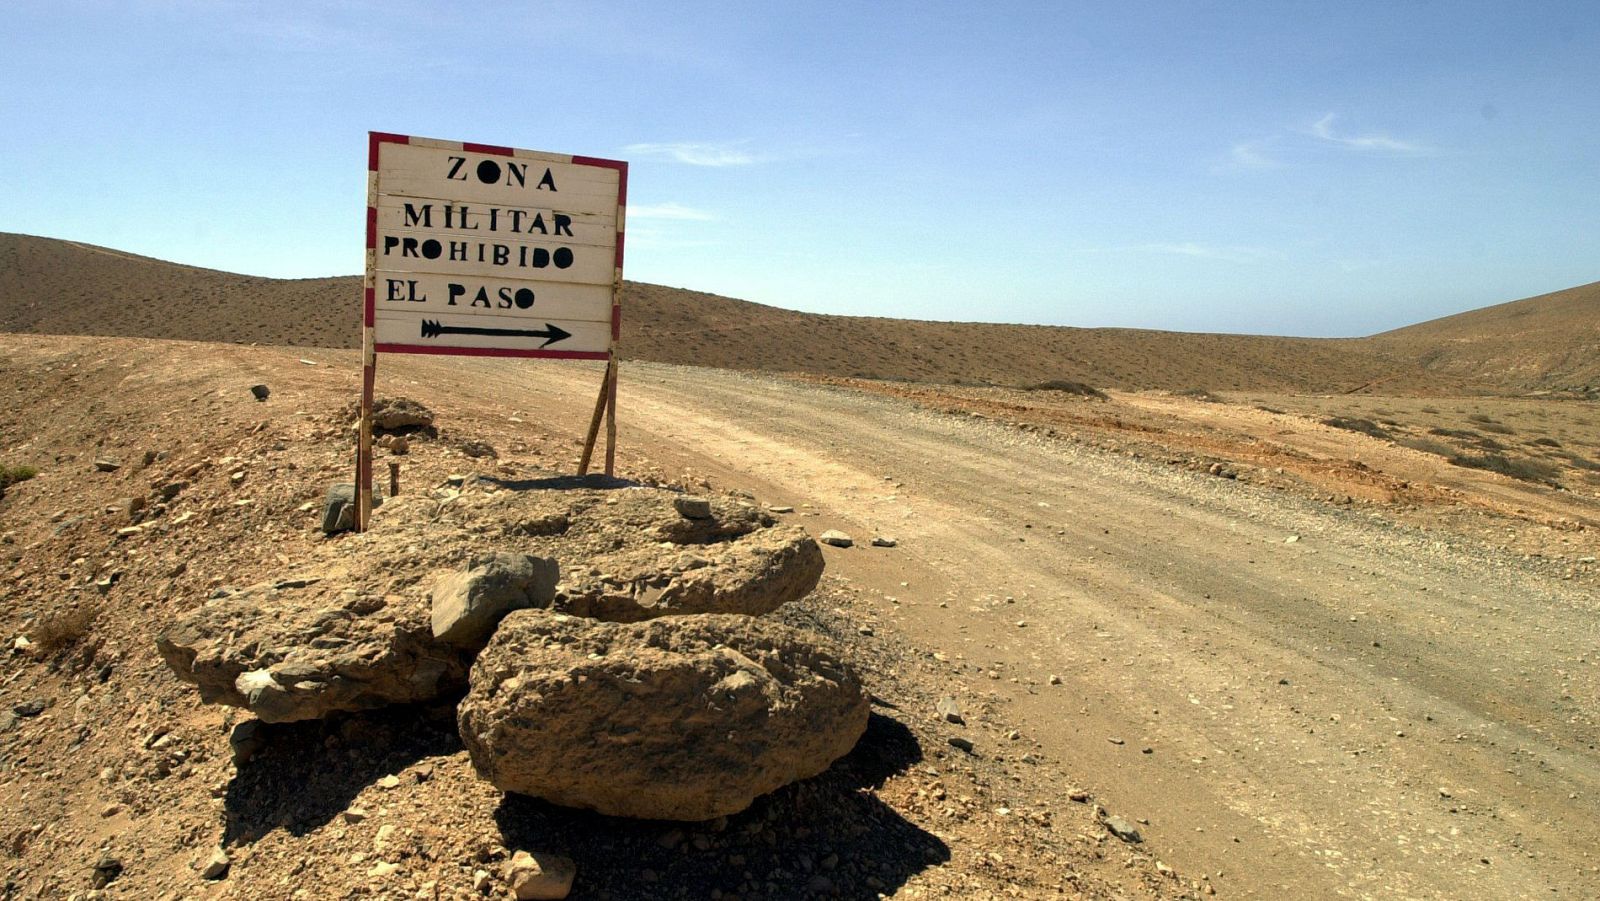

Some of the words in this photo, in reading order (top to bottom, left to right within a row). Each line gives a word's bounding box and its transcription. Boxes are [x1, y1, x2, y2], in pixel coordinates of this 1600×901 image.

[447, 156, 558, 192] ZONA
[403, 203, 574, 237] MILITAR
[384, 235, 574, 269] PROHIBIDO
[386, 279, 427, 302] EL
[447, 283, 535, 309] PASO
